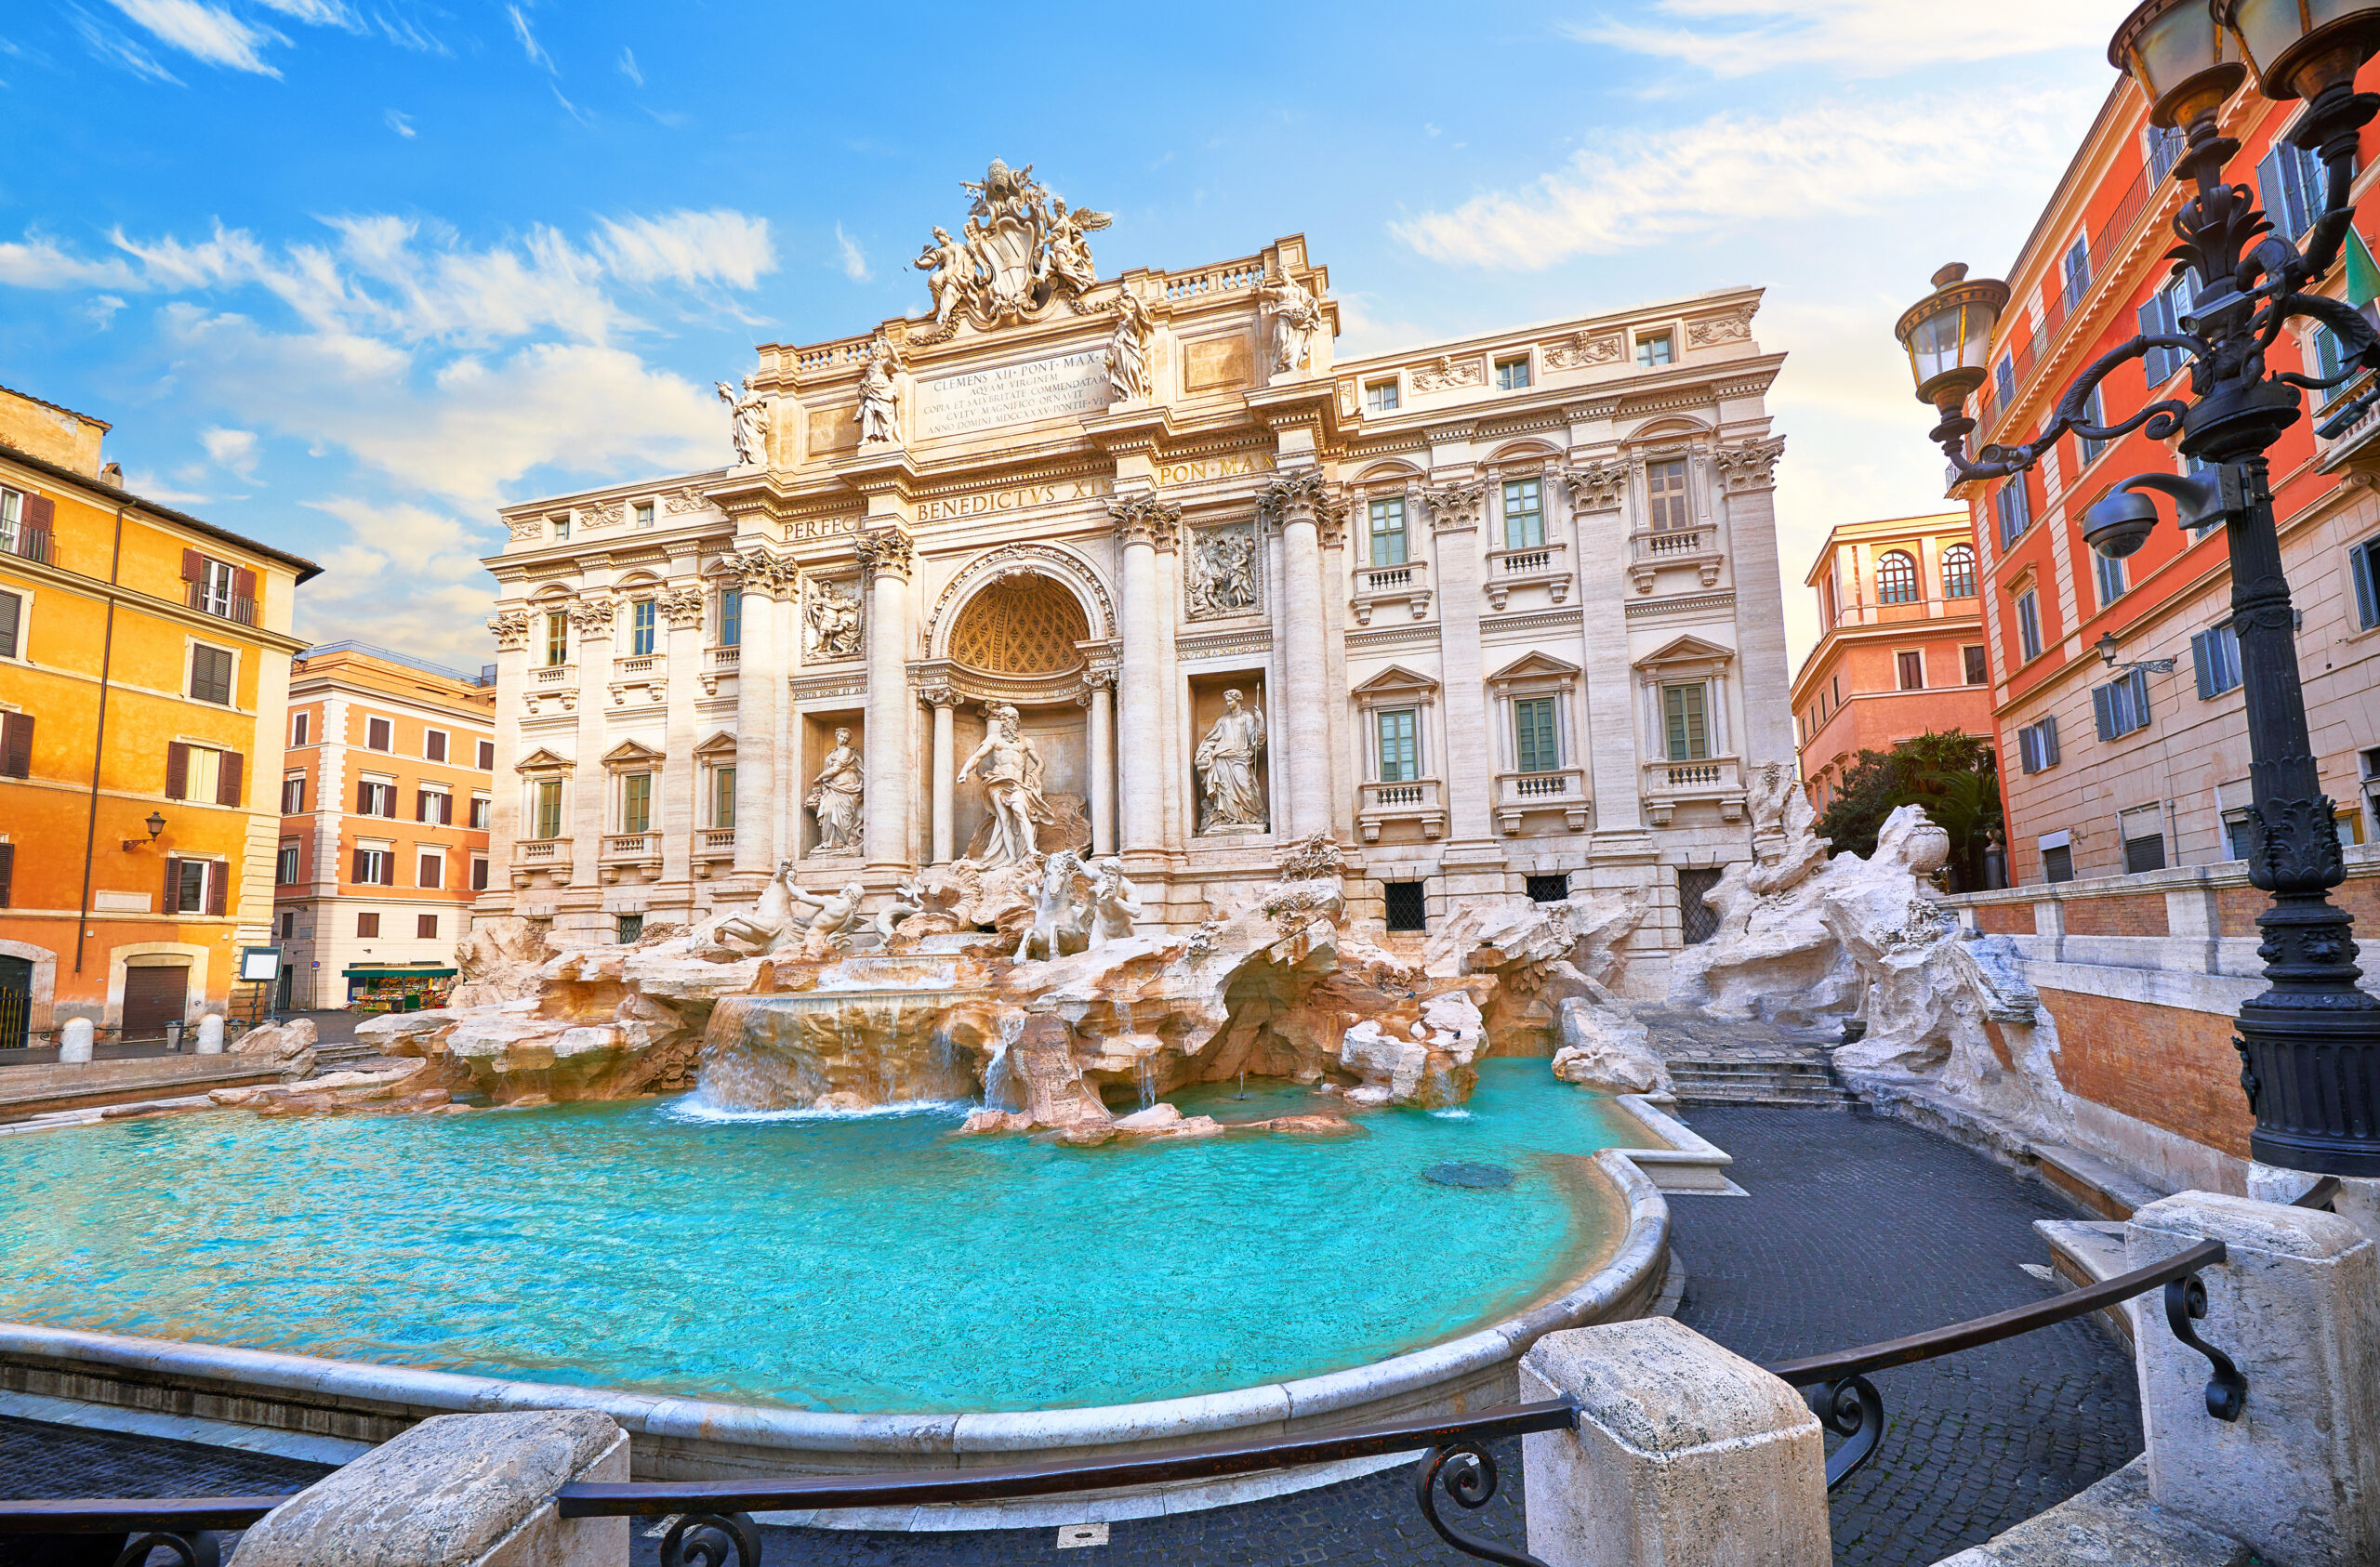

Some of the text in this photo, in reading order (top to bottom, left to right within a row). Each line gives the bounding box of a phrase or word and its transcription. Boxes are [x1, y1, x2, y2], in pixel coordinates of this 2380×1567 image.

[933, 373, 987, 392] CLEMENS
[954, 401, 964, 409] ET
[1030, 375, 1106, 396] COMMENDATAM
[970, 373, 1058, 396] AQVAM VIRGINEM
[1219, 452, 1274, 476] MAX
[918, 485, 1055, 521] BENEDICTVS
